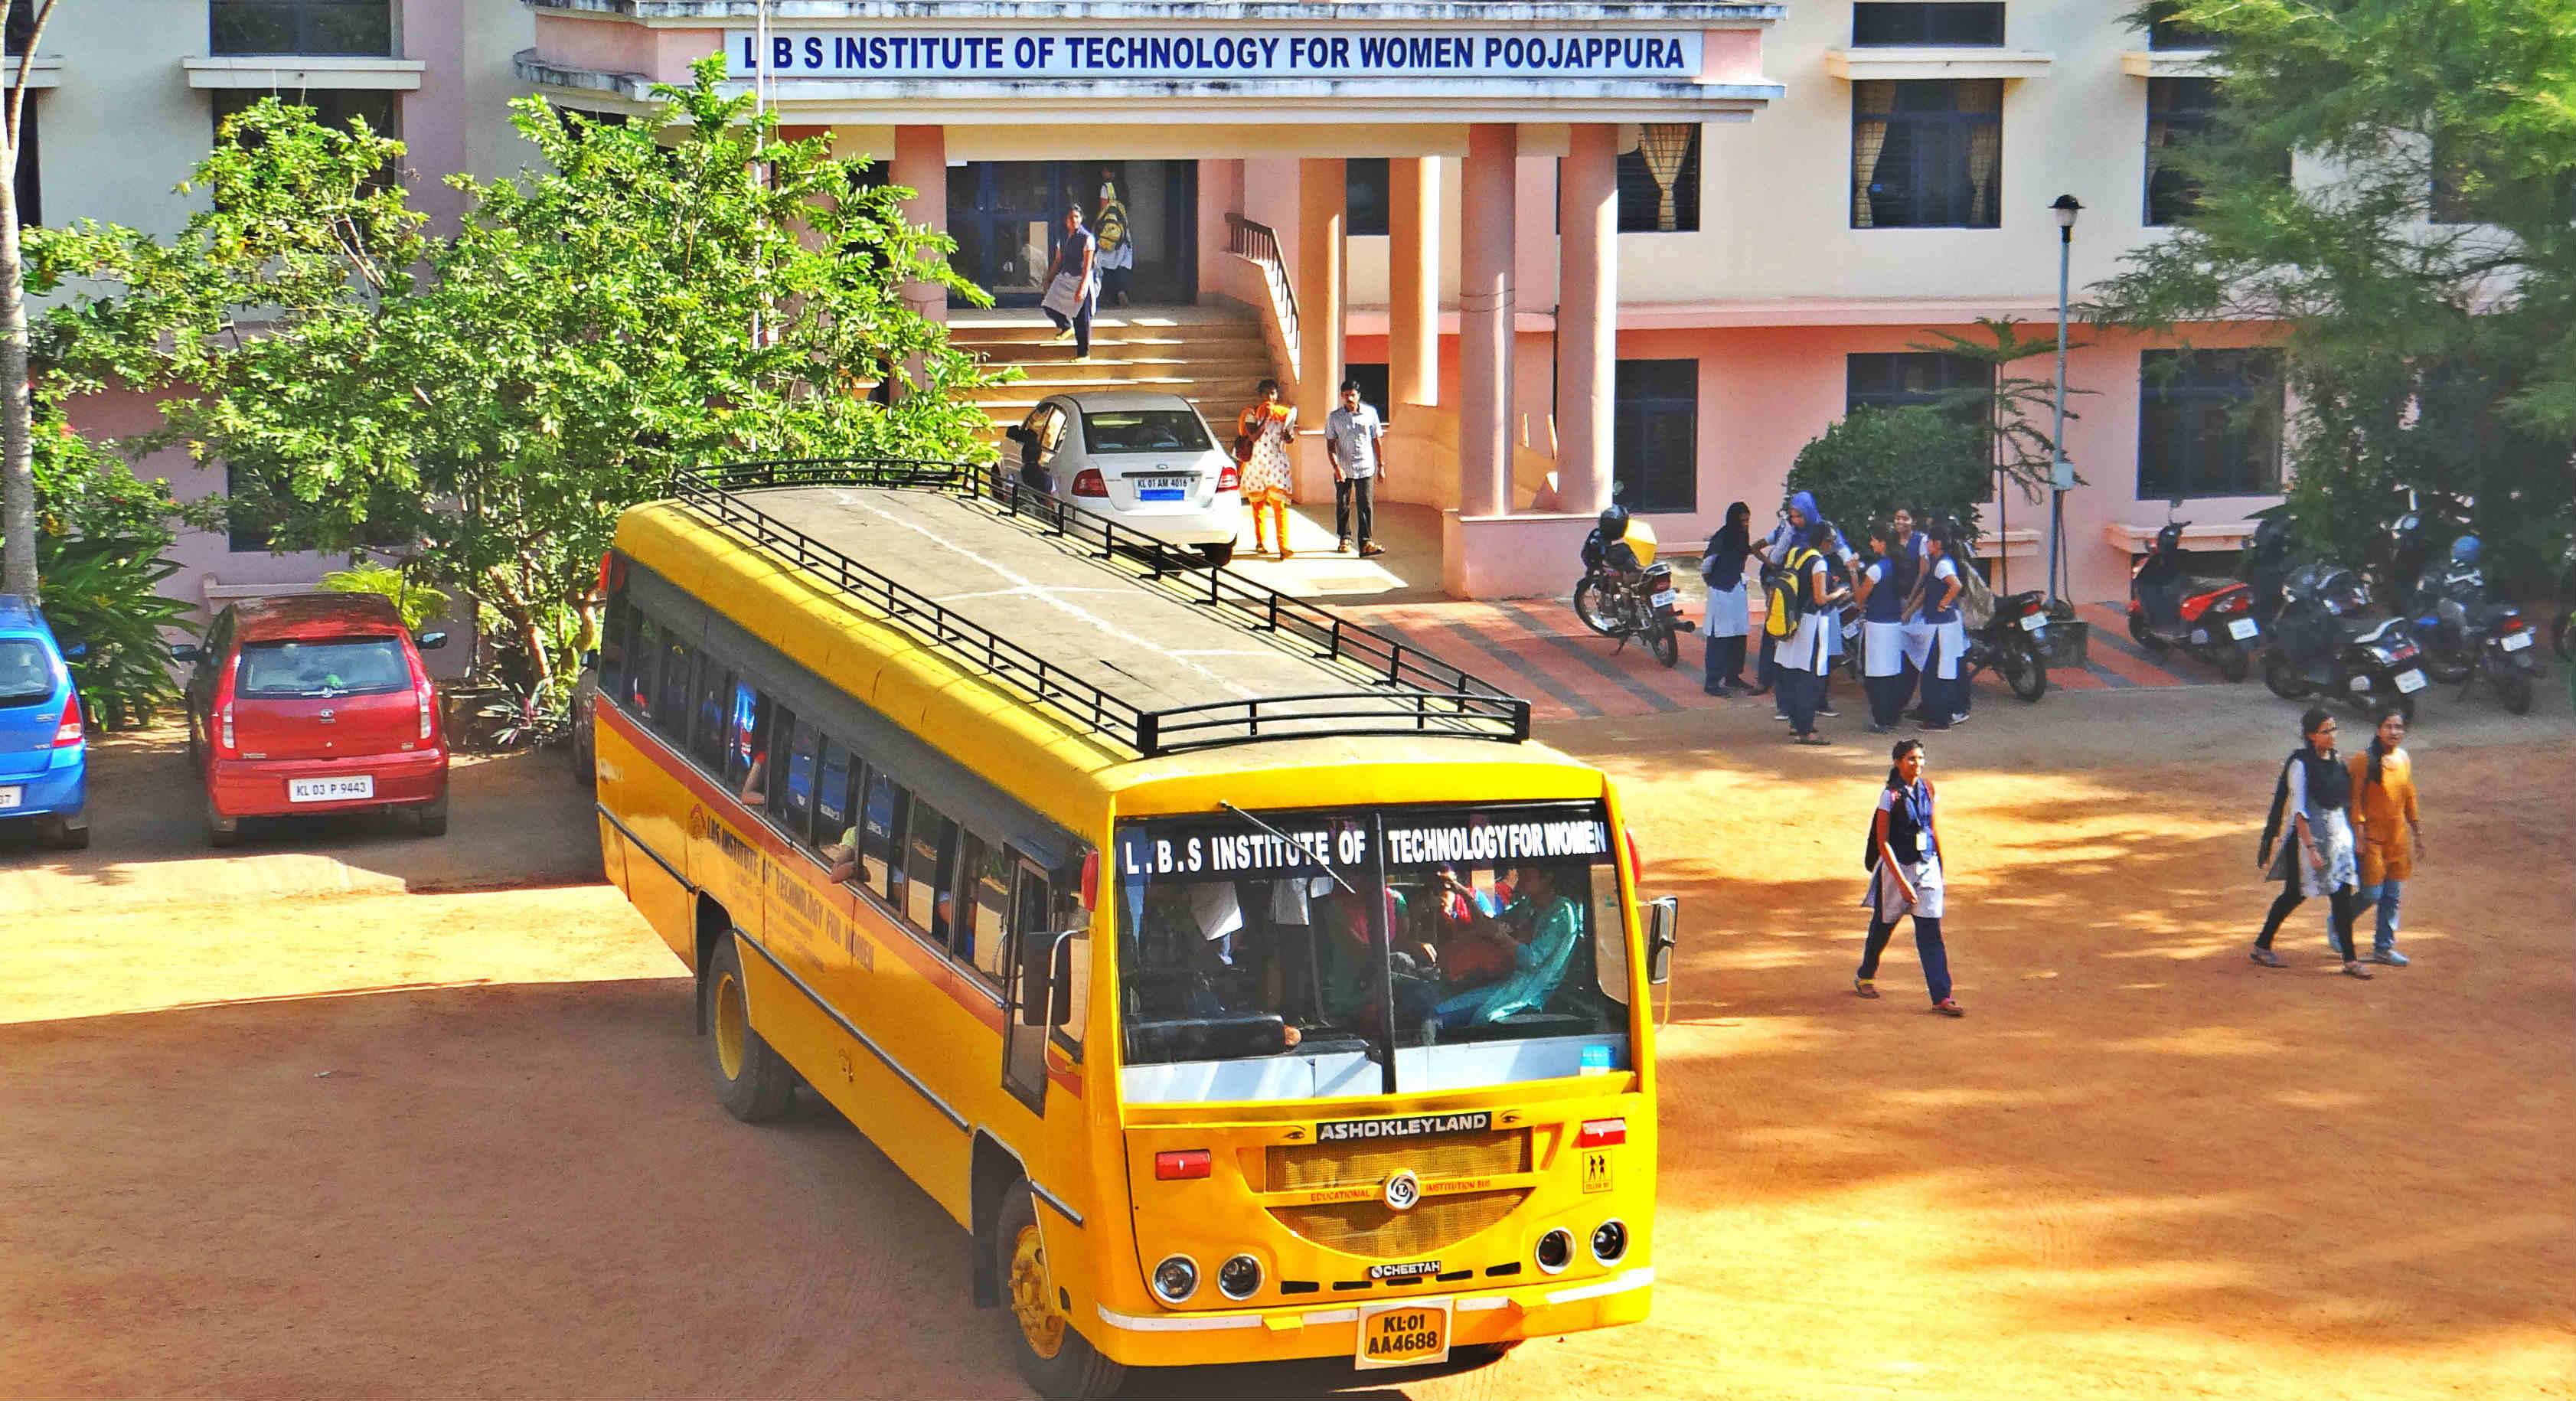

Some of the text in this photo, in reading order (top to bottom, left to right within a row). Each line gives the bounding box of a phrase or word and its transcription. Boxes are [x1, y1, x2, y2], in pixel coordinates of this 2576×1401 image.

[835, 37, 1003, 68] INSTITUTE
[1014, 37, 1055, 68] OF
[1065, 37, 1279, 68] TECHNOLOGY
[1290, 37, 1350, 68] FOR
[1360, 37, 1473, 68] WOMEN
[1485, 38, 1683, 68] POOJAPPURA
[296, 782, 367, 796] KL 03 P 9443
[1211, 831, 1330, 870] INSTITUTE
[1338, 829, 1366, 865] OF
[1387, 820, 1607, 864] TECHNOLOGY FOR WOMEN
[1534, 1122, 1565, 1171] 7
[1311, 1188, 1370, 1202] EDUCATIONAL
[1383, 1262, 1441, 1277] CHEETAH
[1368, 1331, 1437, 1354] AA4688
